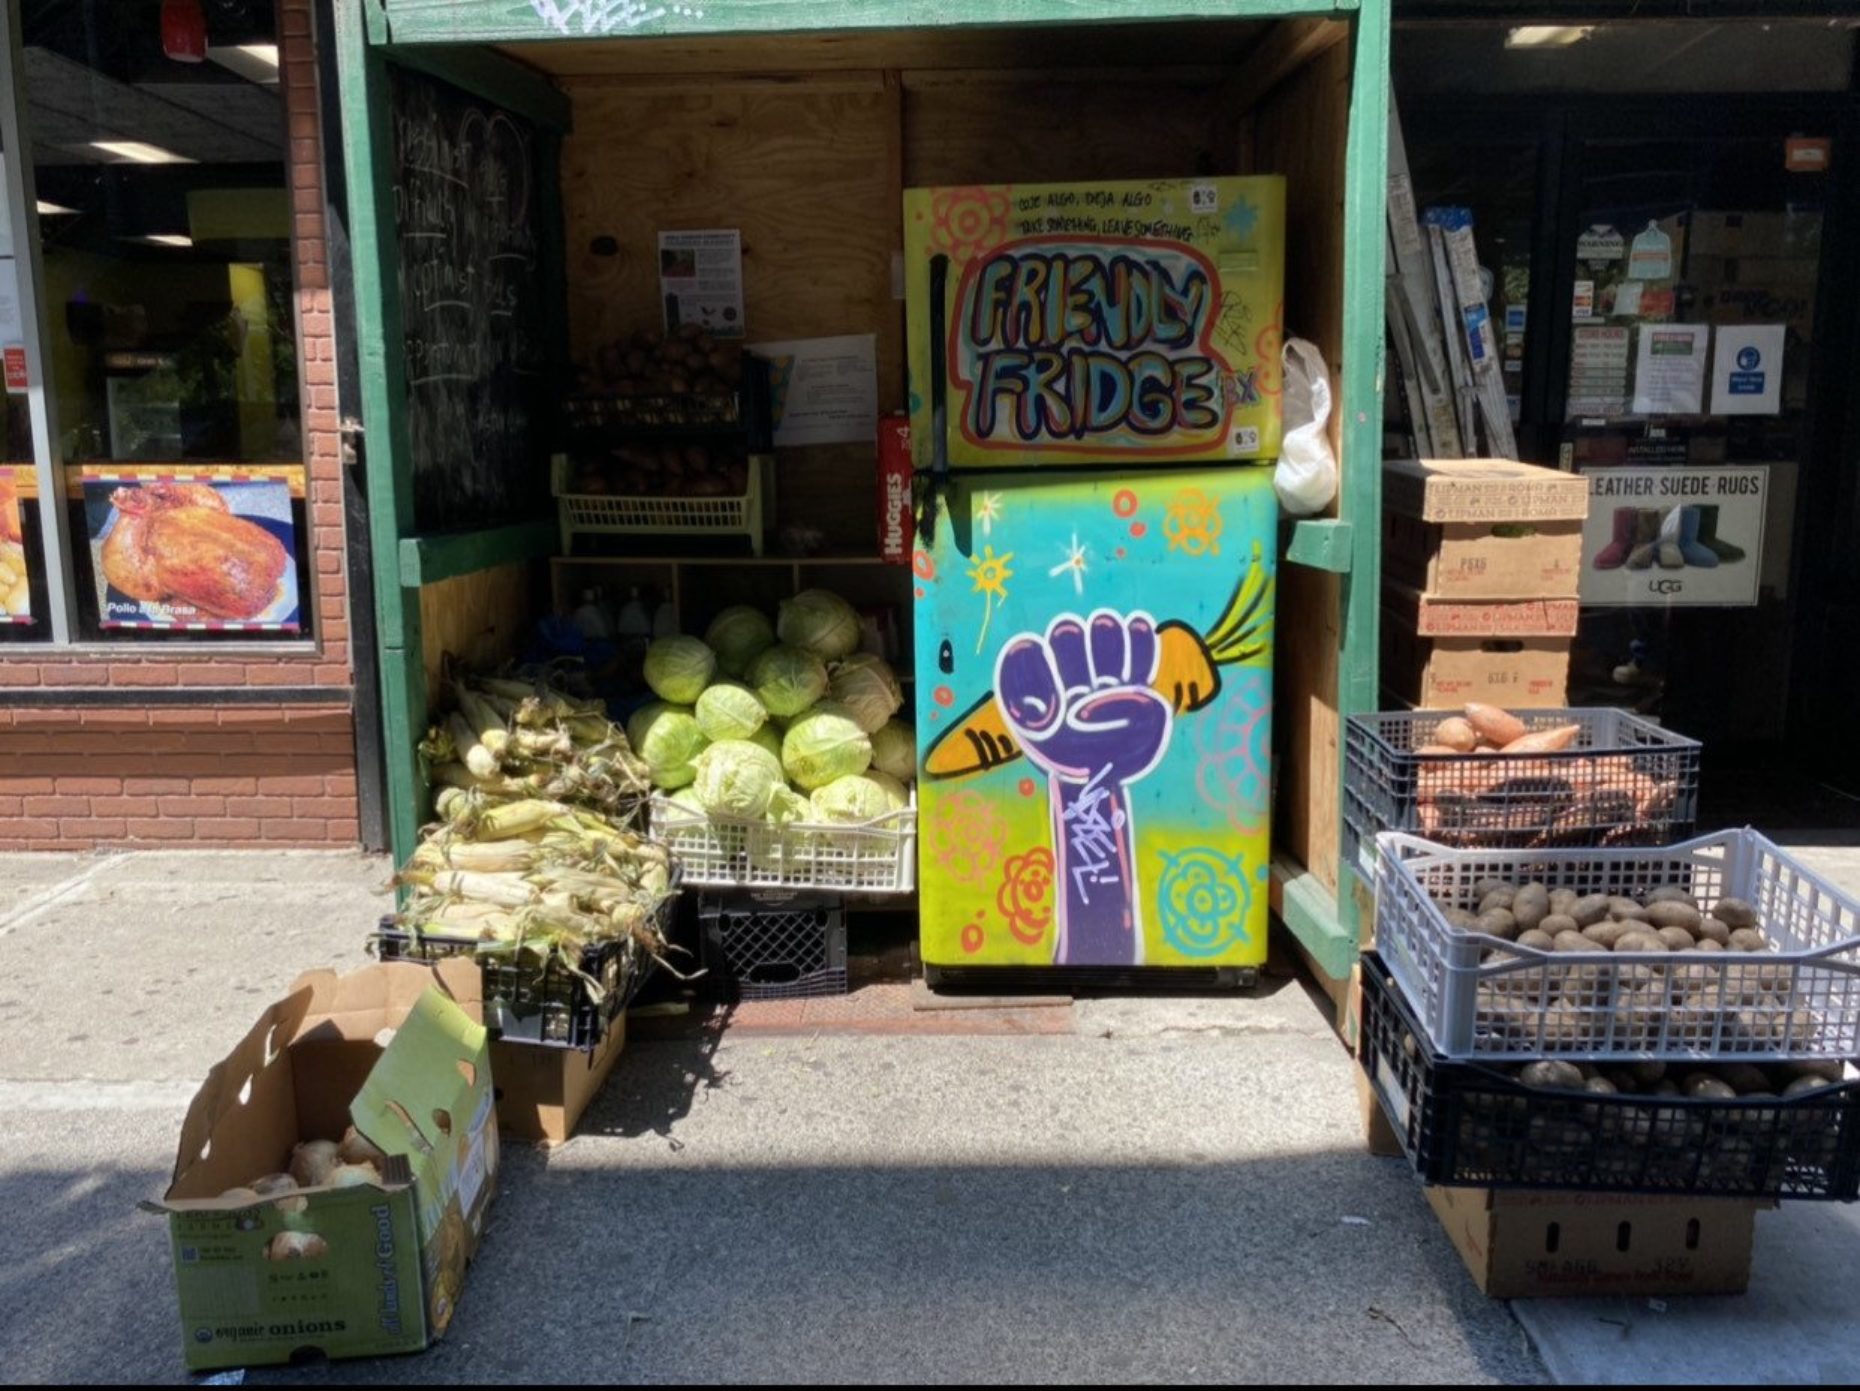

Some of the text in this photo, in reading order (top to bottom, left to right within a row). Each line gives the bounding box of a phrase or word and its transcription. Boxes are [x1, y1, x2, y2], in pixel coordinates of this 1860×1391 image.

[1102, 218, 1134, 235] LEAVE
[970, 252, 1209, 350] FRIENDLY
[975, 347, 1220, 440] FRIDGE
[1589, 475, 1760, 496] EATHER SUEDE RUGS
[884, 472, 903, 554] HUGGIES
[1649, 579, 1683, 595] UGG
[107, 602, 137, 614] Pollo
[161, 603, 197, 615] Brasa
[369, 1203, 394, 1258] Good
[215, 1322, 264, 1343] organic
[269, 1319, 346, 1336] onions
